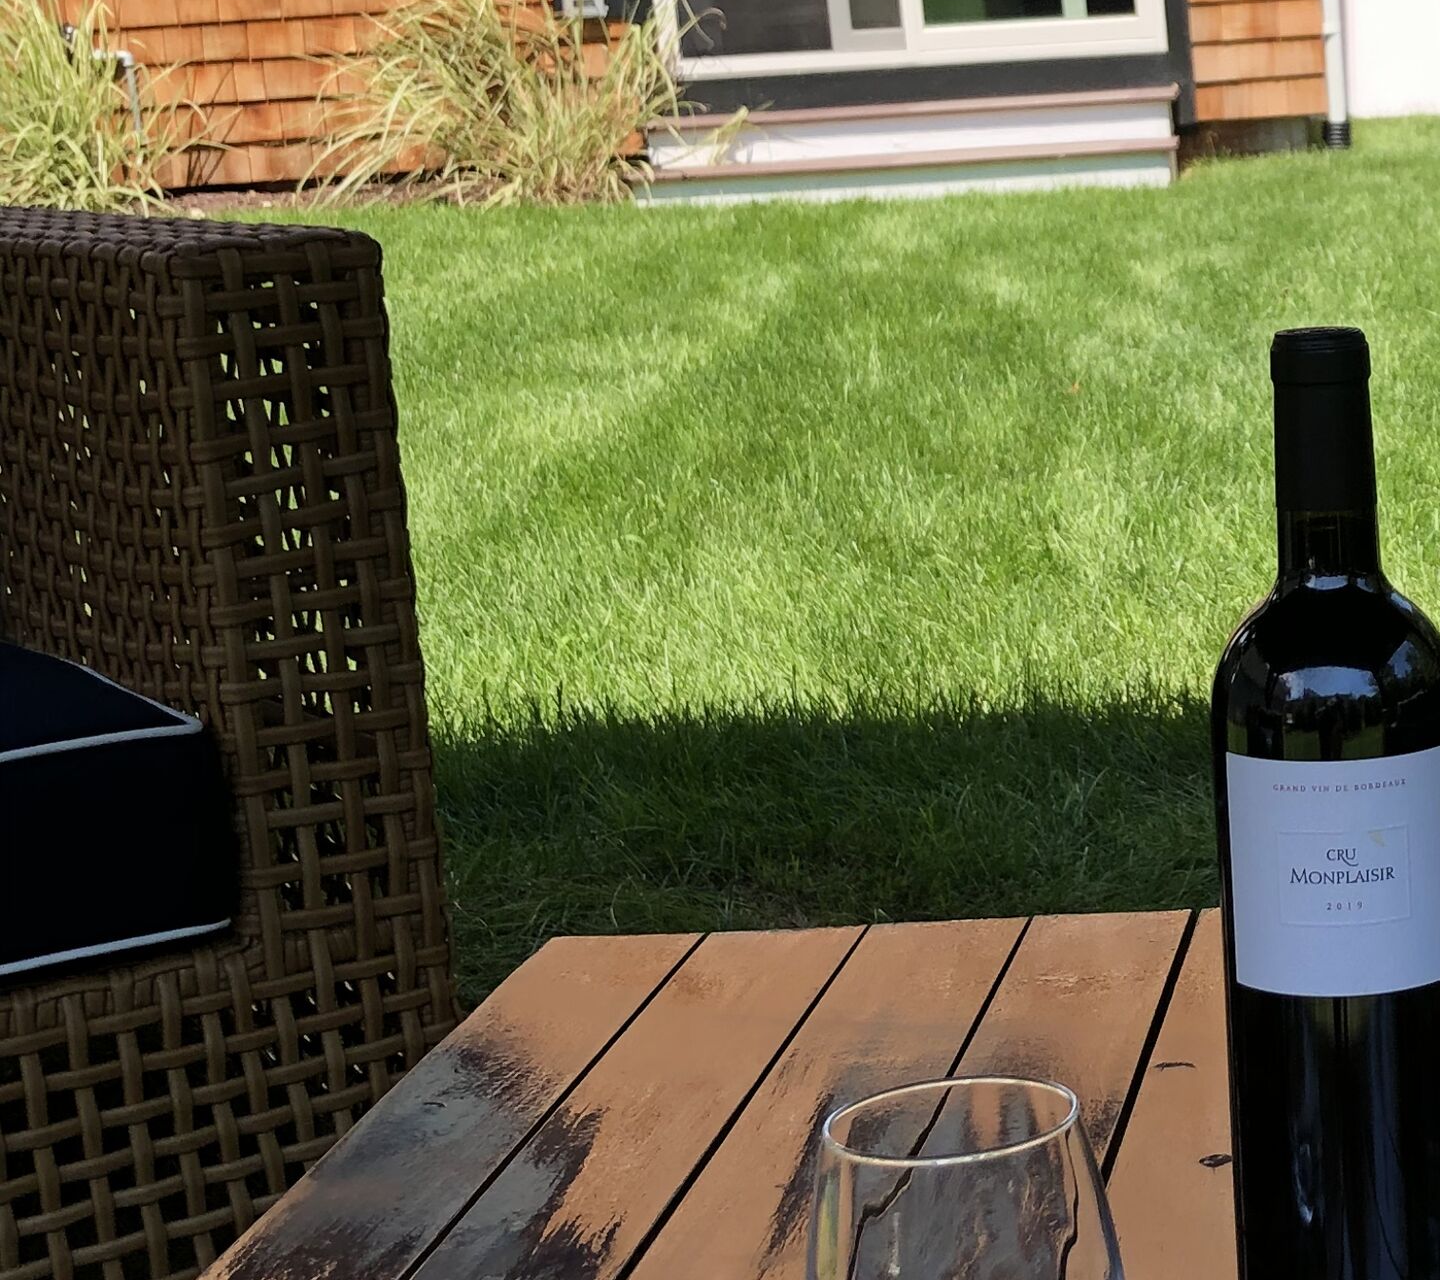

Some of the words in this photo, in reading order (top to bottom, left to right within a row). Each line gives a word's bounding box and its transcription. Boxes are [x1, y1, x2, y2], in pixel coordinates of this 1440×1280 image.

[1272, 784, 1306, 793] GRAND
[1311, 784, 1330, 793] VIN
[1335, 784, 1349, 793] DE
[1326, 847, 1360, 867] CRU
[1289, 866, 1396, 885] MONPLAISIR
[1326, 901, 1363, 911] 2019
